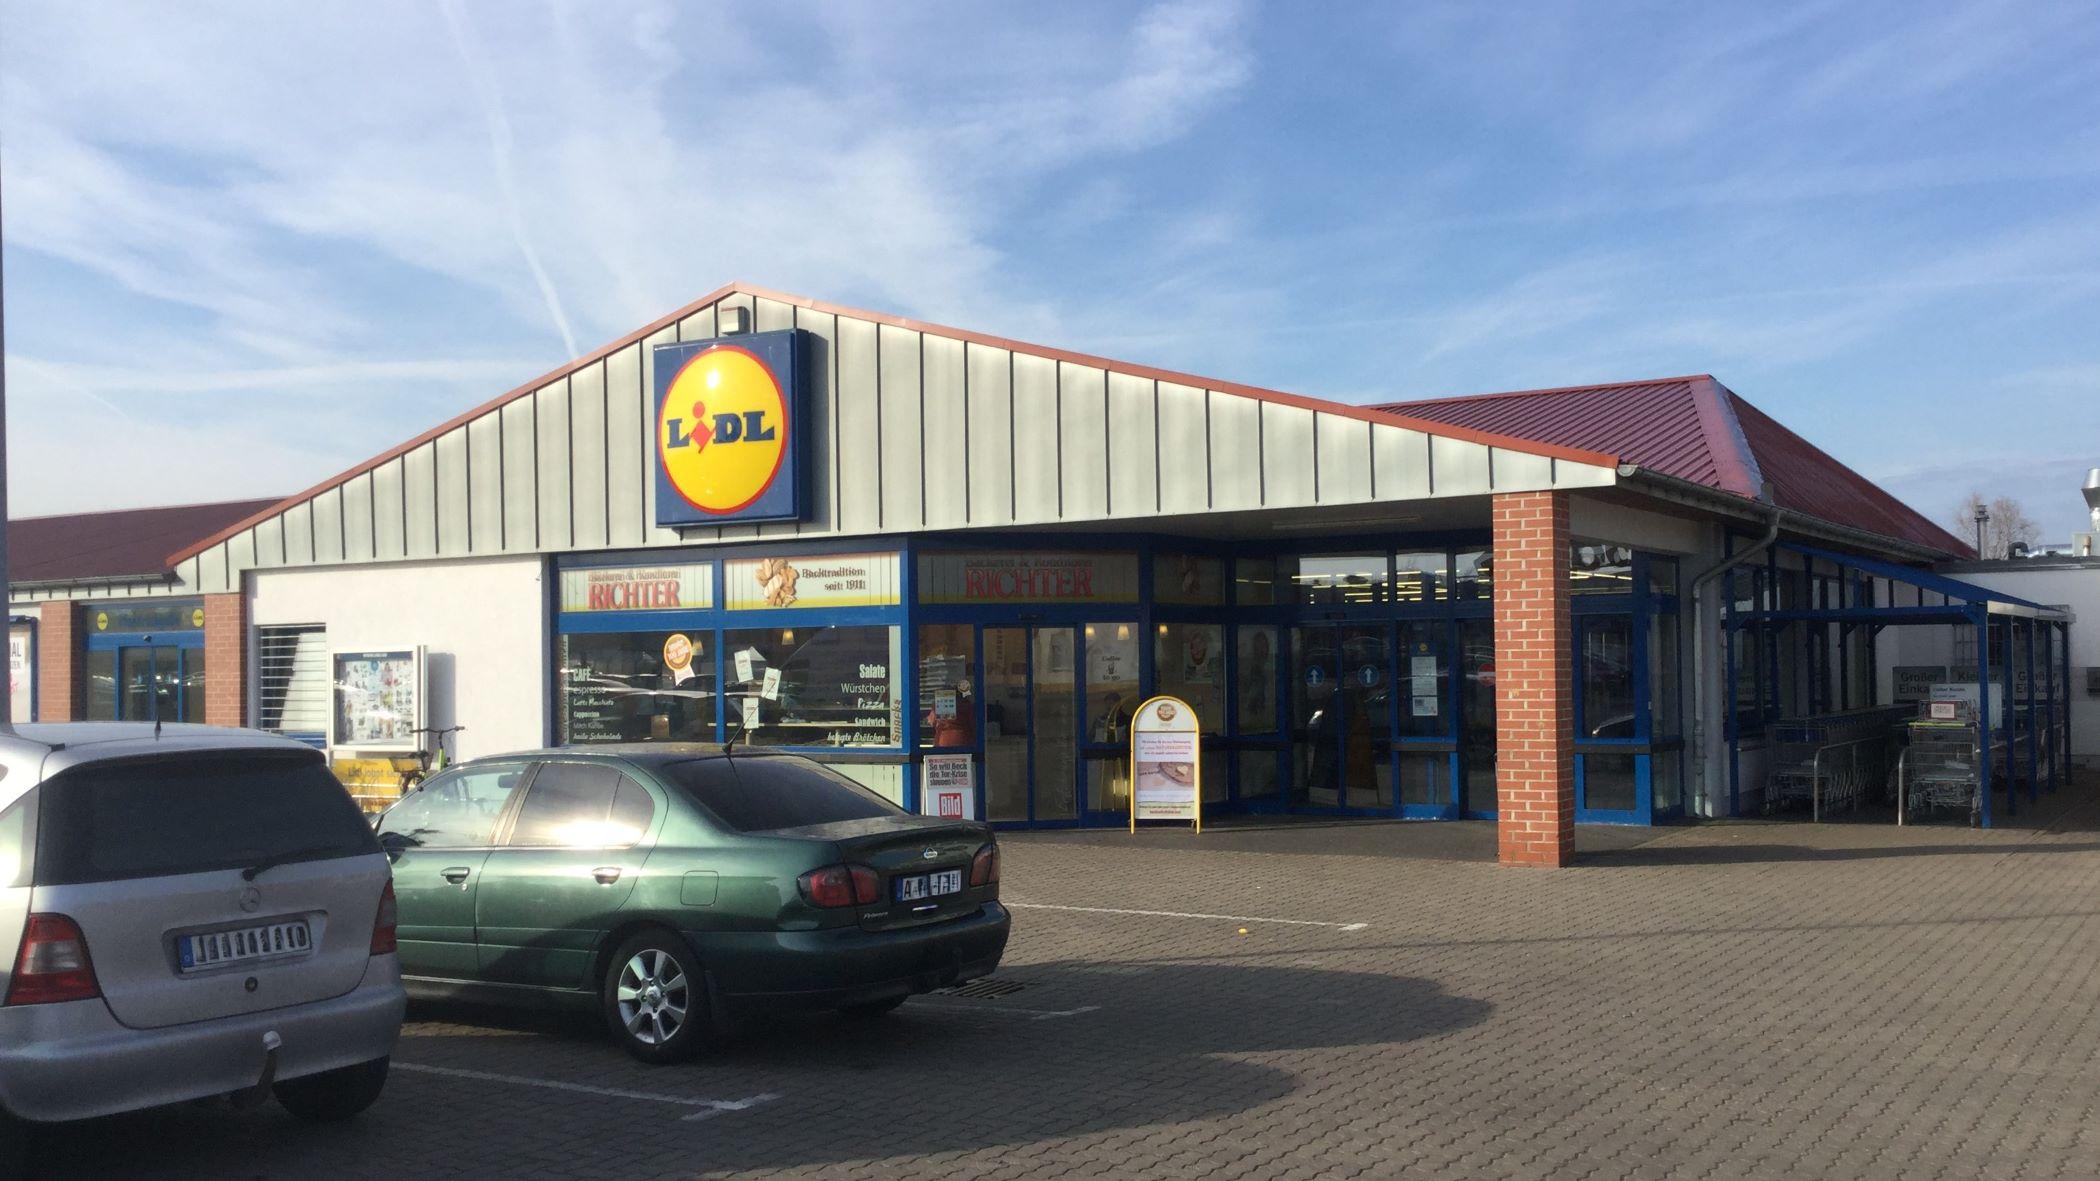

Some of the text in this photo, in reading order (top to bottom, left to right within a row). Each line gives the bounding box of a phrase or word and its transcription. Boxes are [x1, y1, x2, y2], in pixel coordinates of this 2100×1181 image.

[802, 567, 866, 579] Backtradition
[824, 581, 843, 591] seit
[965, 567, 1095, 599] RICHTER
[588, 579, 681, 609] RICHTER
[859, 663, 886, 679] Salate
[1901, 671, 1938, 682] Großer
[573, 685, 606, 696] espresso
[840, 682, 886, 694] Würstchen
[1899, 683, 1930, 694] Einka
[857, 697, 885, 710] Pizza
[854, 717, 886, 727] Sandwich
[891, 699, 901, 743] Snacks
[853, 731, 886, 743] Brötchen
[941, 795, 961, 816] Bild
